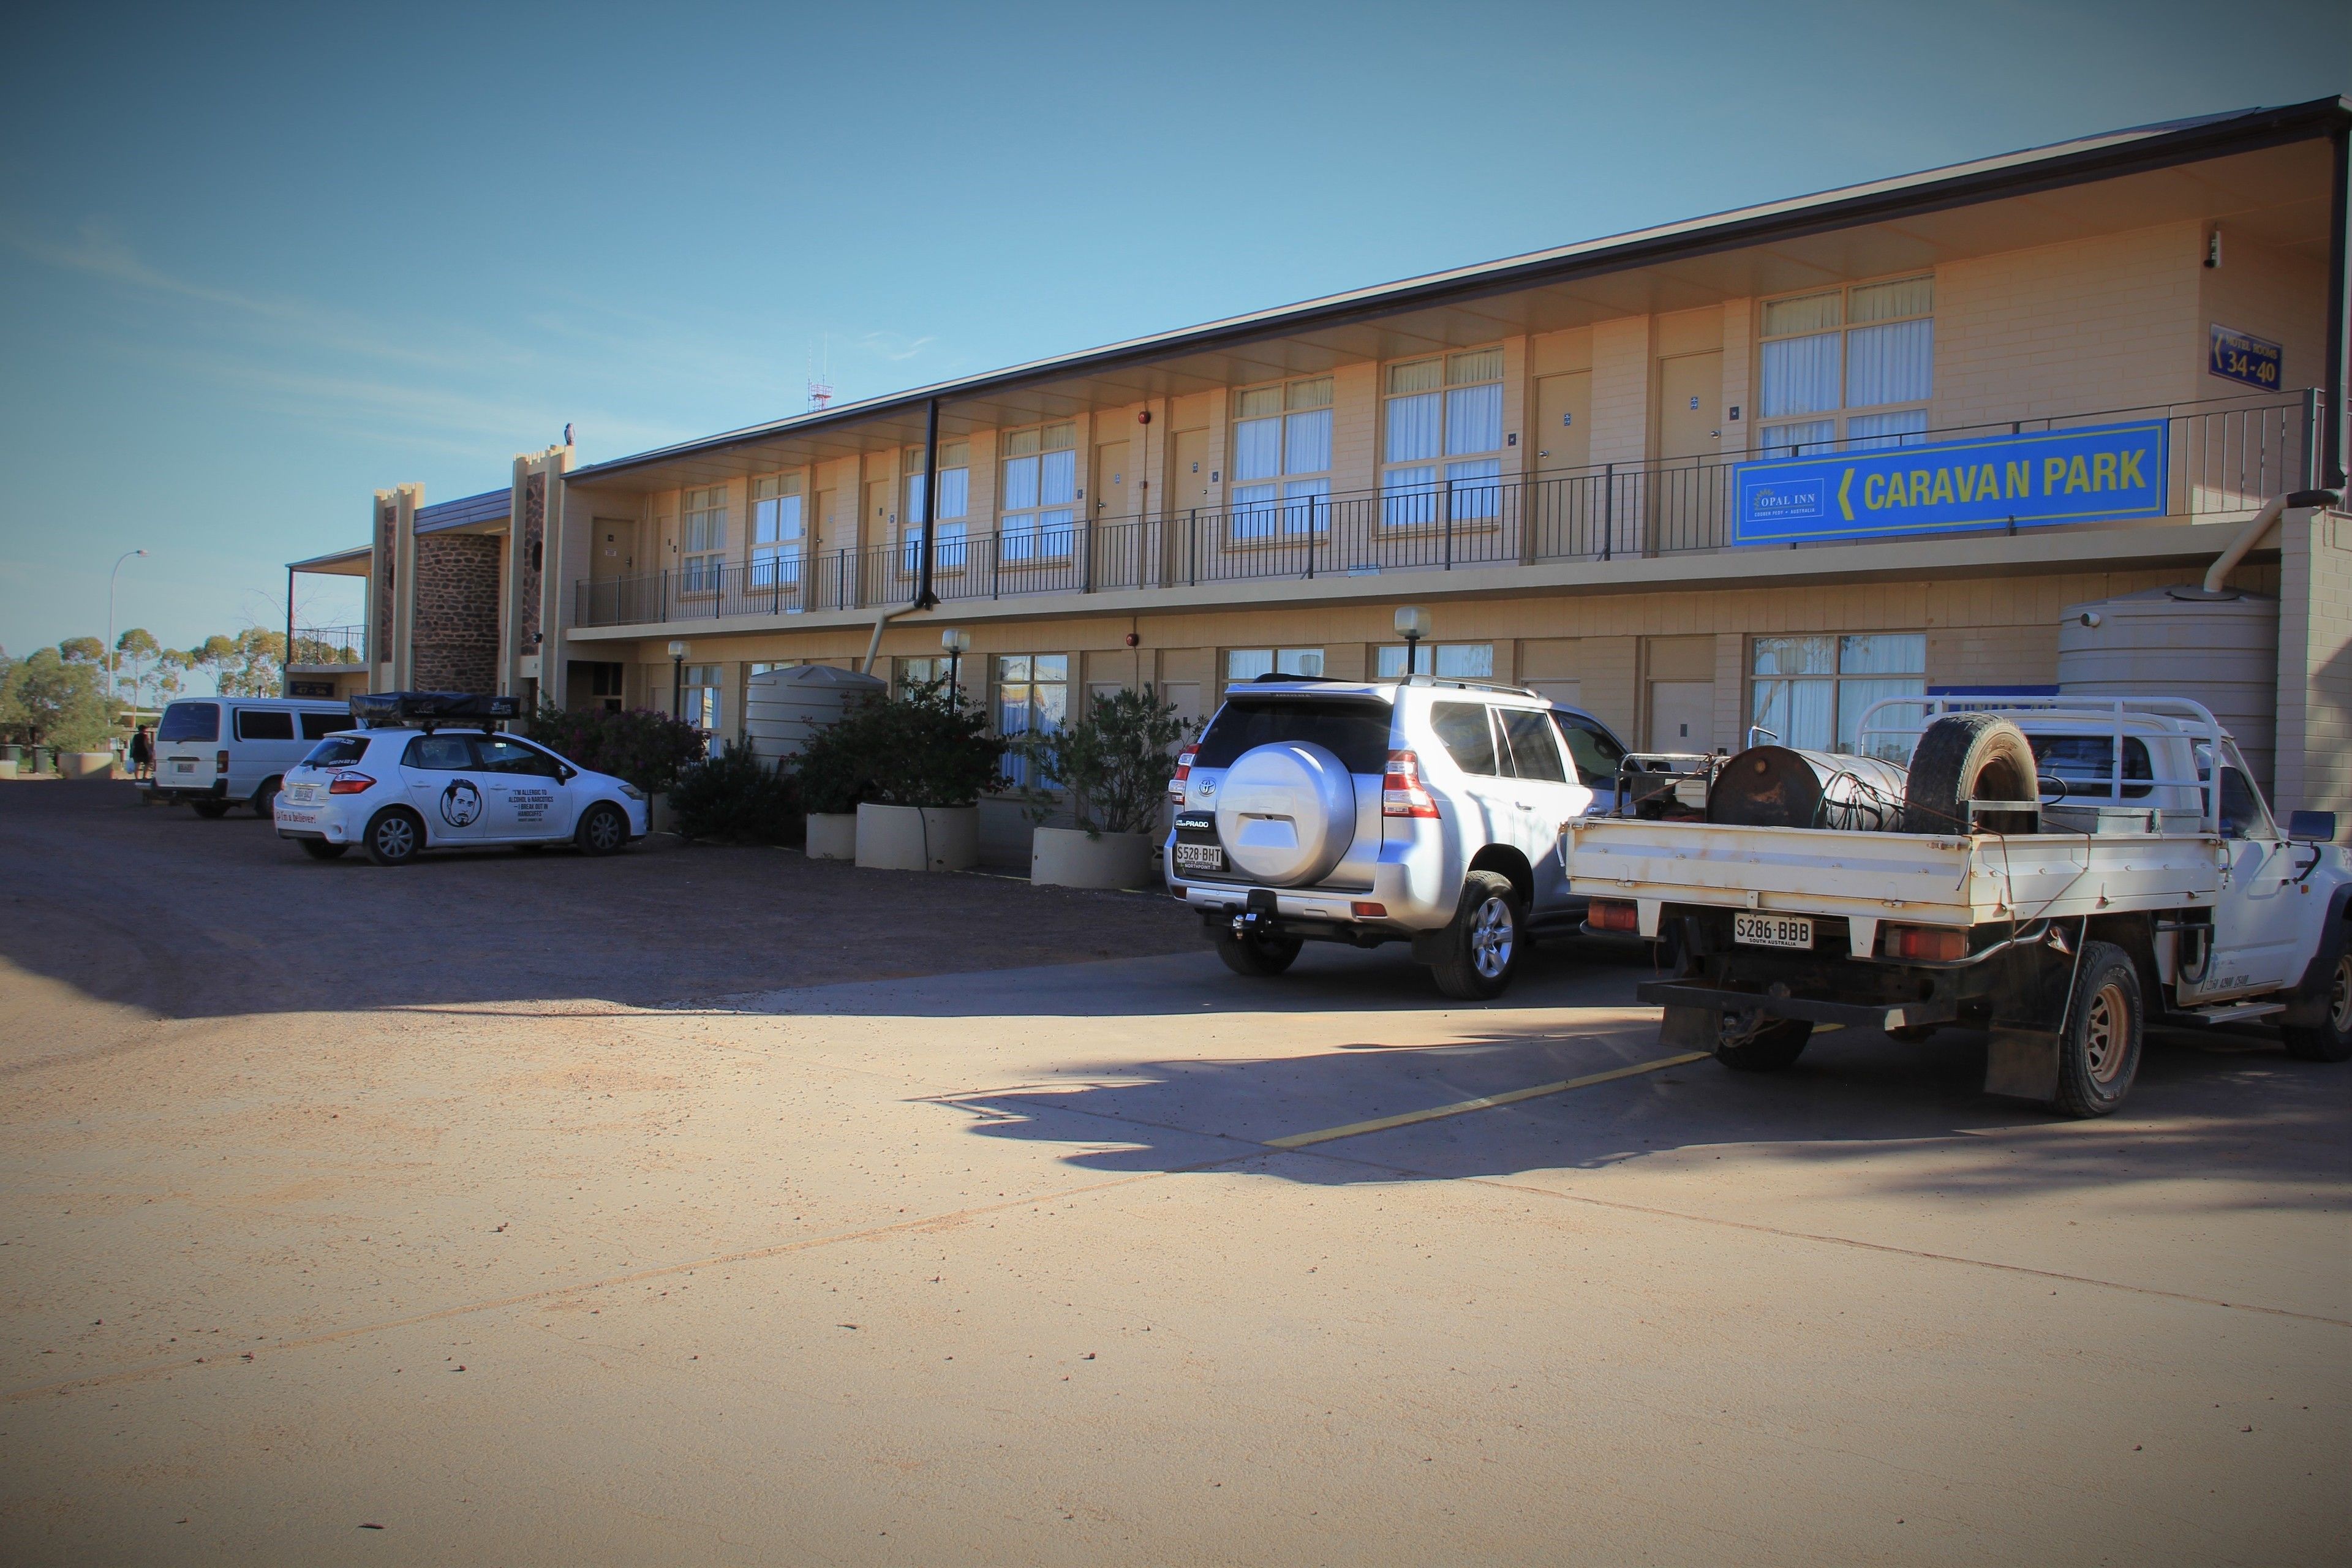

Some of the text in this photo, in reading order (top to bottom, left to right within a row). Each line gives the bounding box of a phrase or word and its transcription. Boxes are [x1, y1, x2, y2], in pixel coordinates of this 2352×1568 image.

[2225, 334, 2278, 360] MOTEL ROOMS
[1864, 449, 2147, 510] CARAVAN PARK
[1761, 493, 1815, 507] OPAL INN
